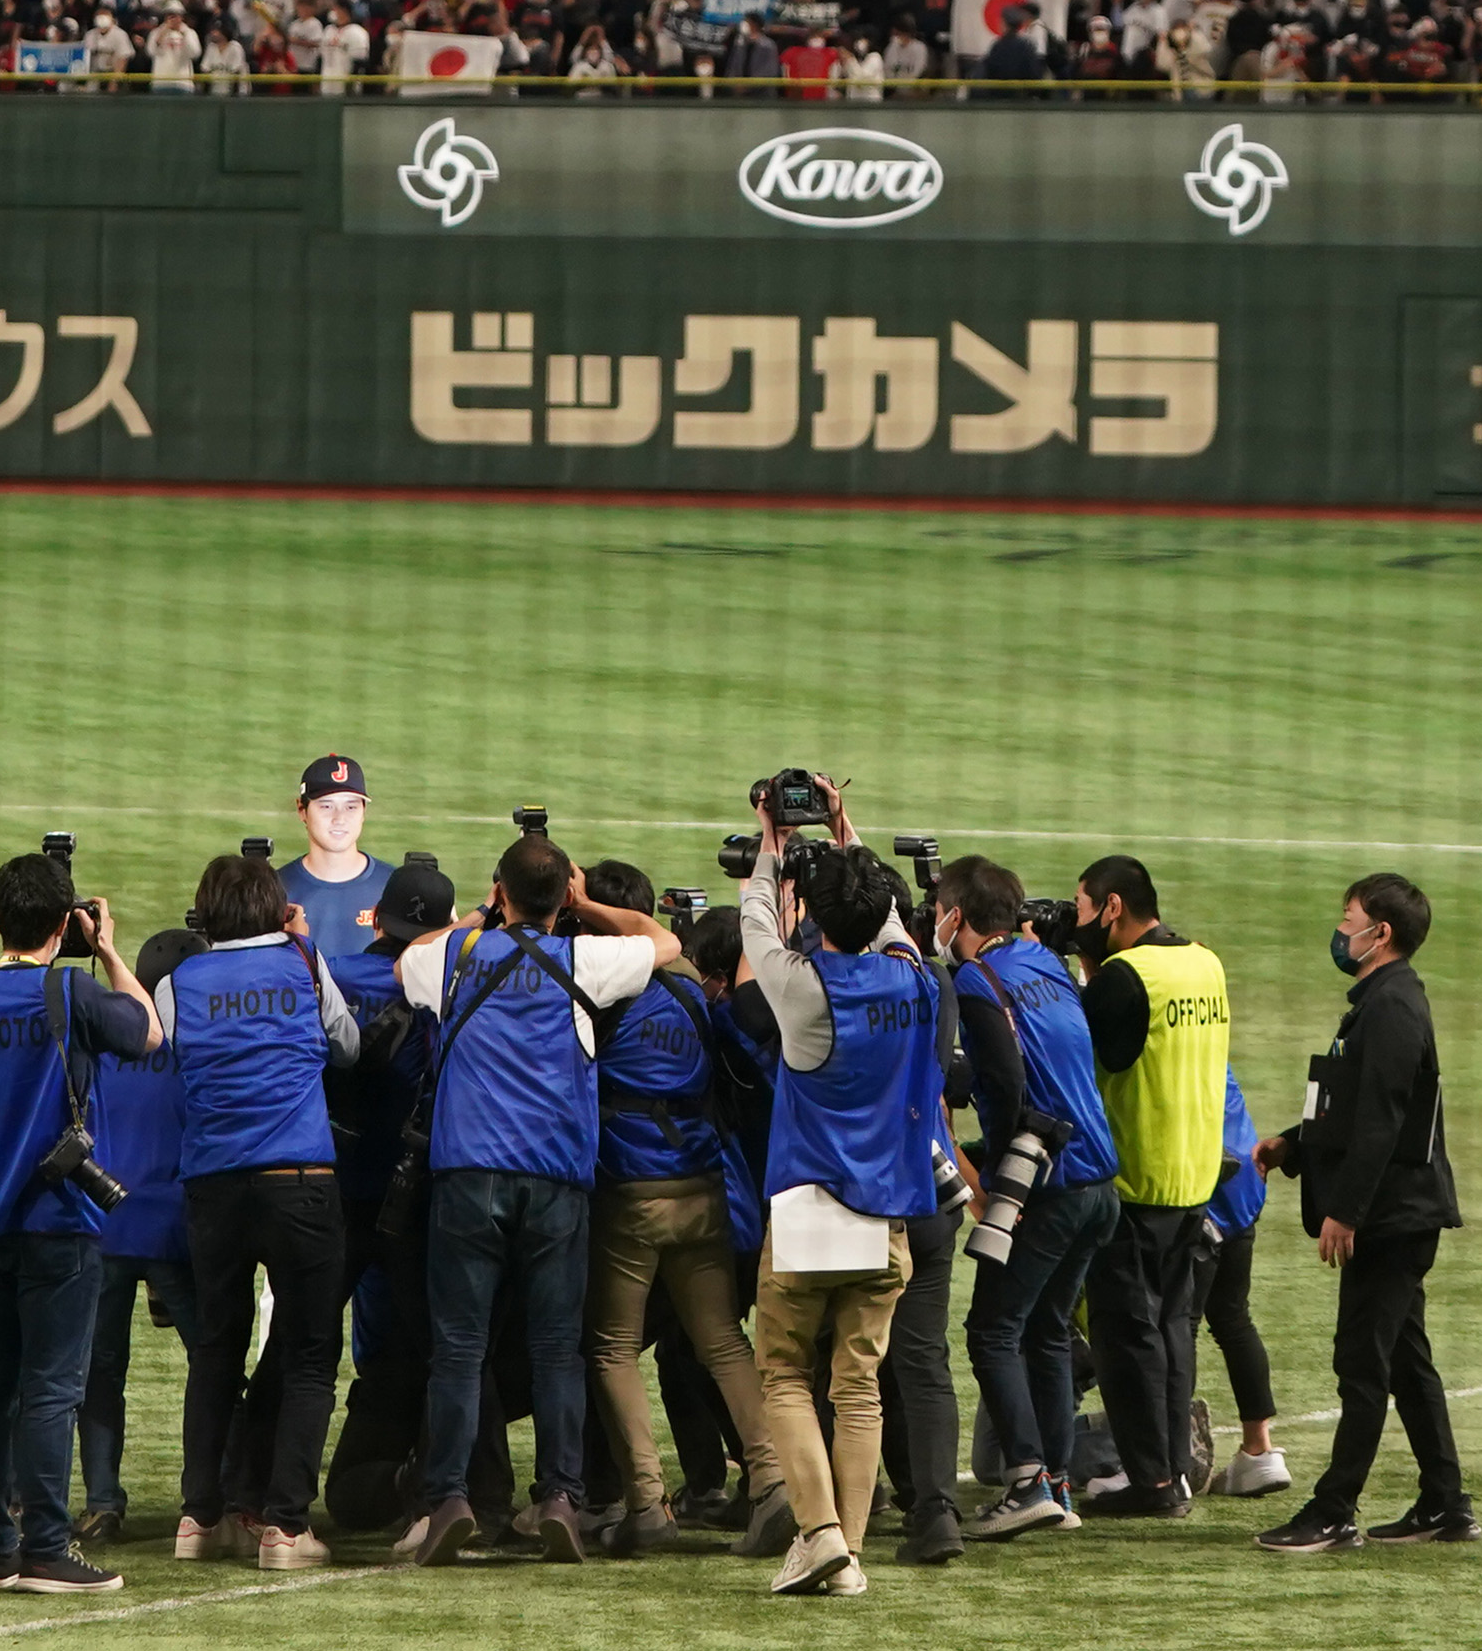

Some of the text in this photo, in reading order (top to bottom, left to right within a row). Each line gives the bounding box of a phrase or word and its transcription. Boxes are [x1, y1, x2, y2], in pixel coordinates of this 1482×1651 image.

[756, 144, 933, 204] Kowa
[410, 310, 1219, 459] ビックカメラ
[331, 761, 349, 783] J
[209, 988, 297, 1021] PHOTO
[1011, 977, 1060, 1012] HOTO
[1166, 995, 1228, 1028] OFFICIAL
[640, 1018, 702, 1059] PHOT
